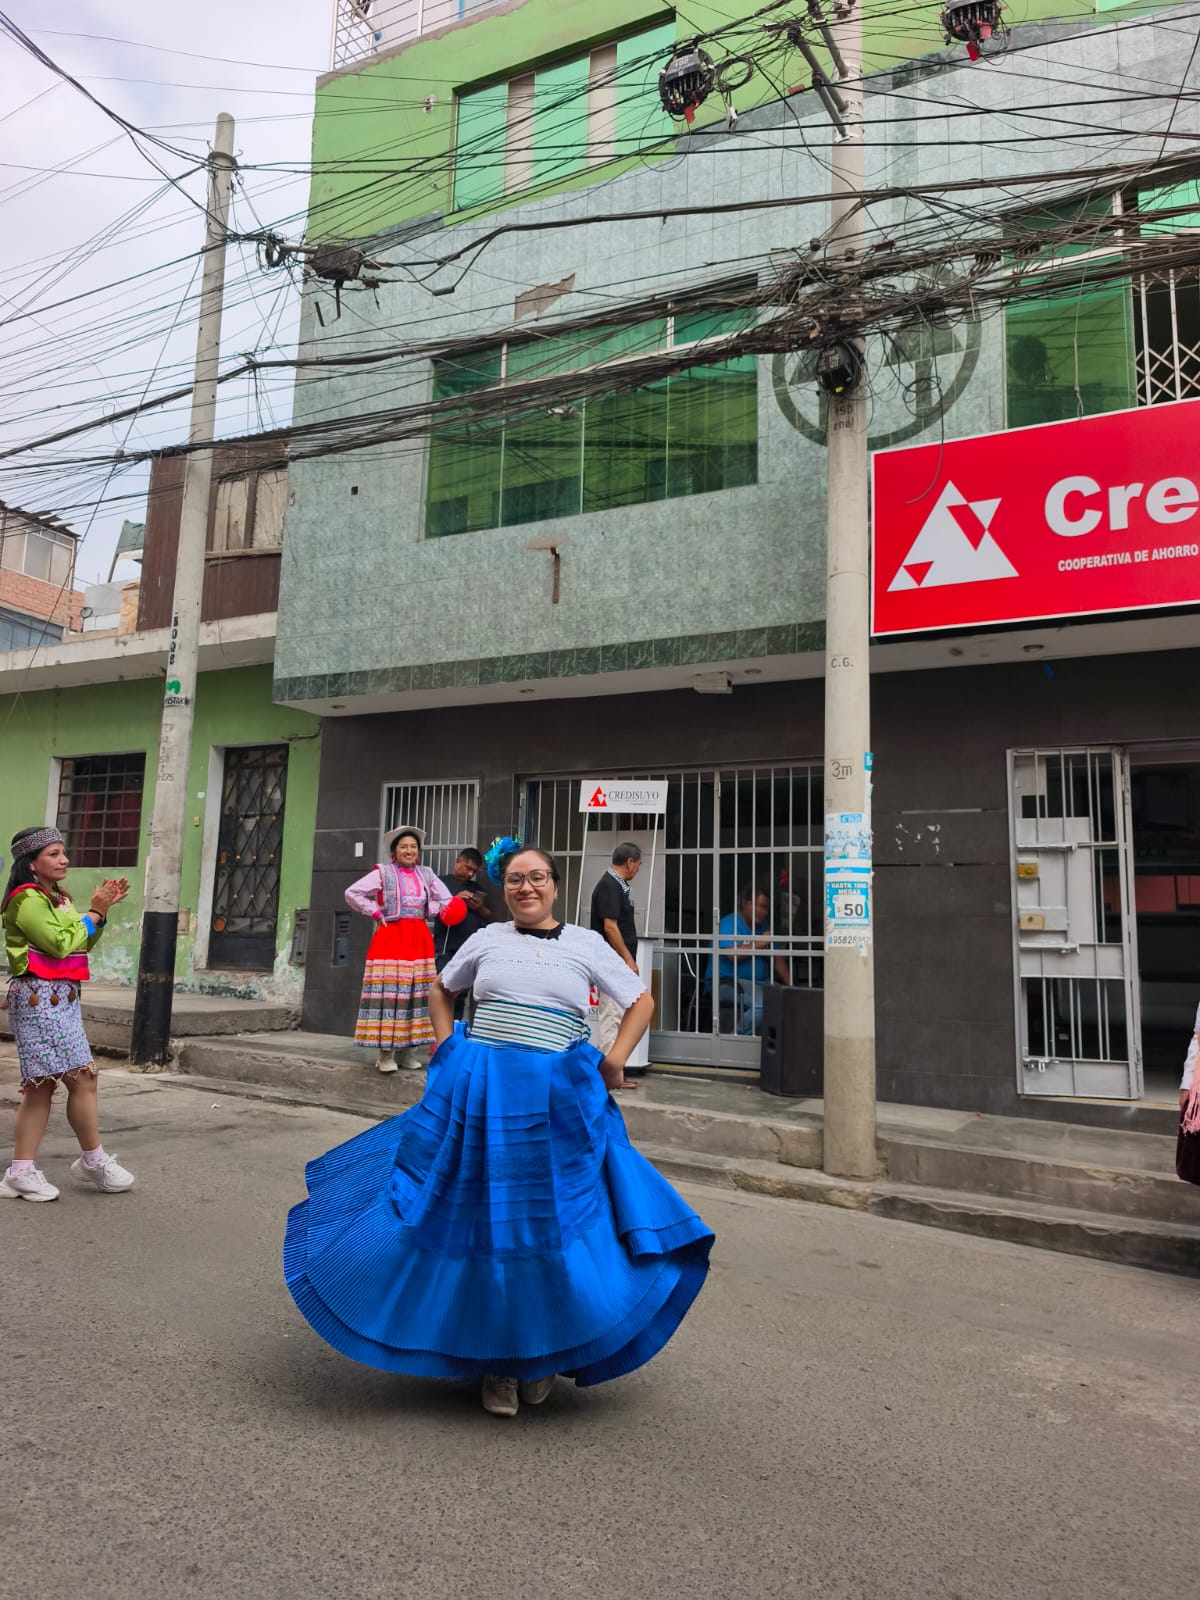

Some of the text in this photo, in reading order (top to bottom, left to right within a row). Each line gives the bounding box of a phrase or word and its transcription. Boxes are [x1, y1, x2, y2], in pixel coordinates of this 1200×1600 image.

[1045, 475, 1200, 537] Cre
[1058, 544, 1199, 571] COOPERATIVA DE AHORRO
[608, 791, 659, 800] CREDISUYO
[844, 903, 864, 917] 50
